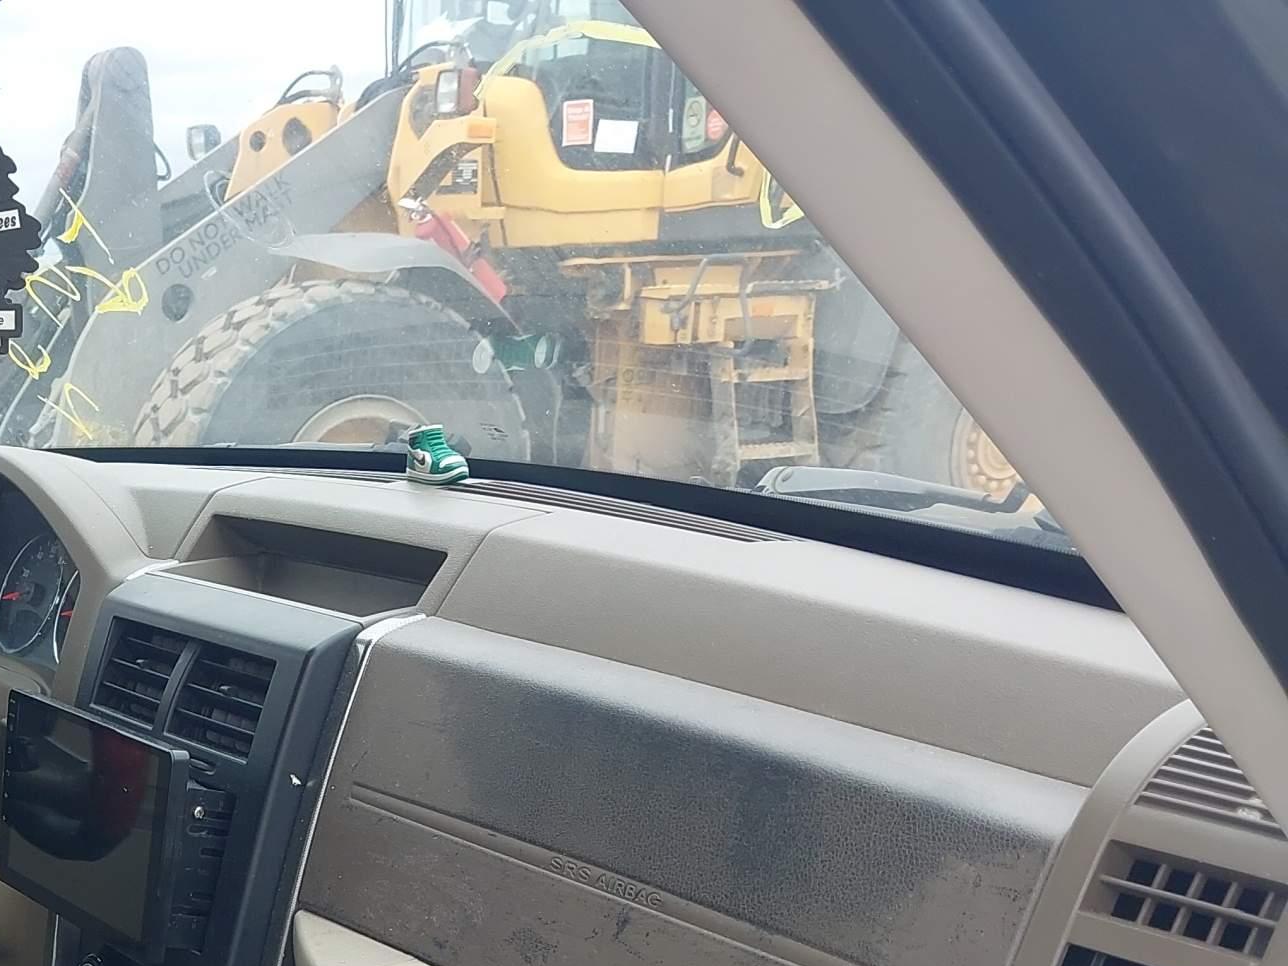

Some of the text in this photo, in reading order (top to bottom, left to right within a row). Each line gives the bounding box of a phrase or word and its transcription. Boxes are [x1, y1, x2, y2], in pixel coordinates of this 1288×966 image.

[156, 246, 185, 275] DO
[551, 856, 663, 907] SRS AIRBAG
